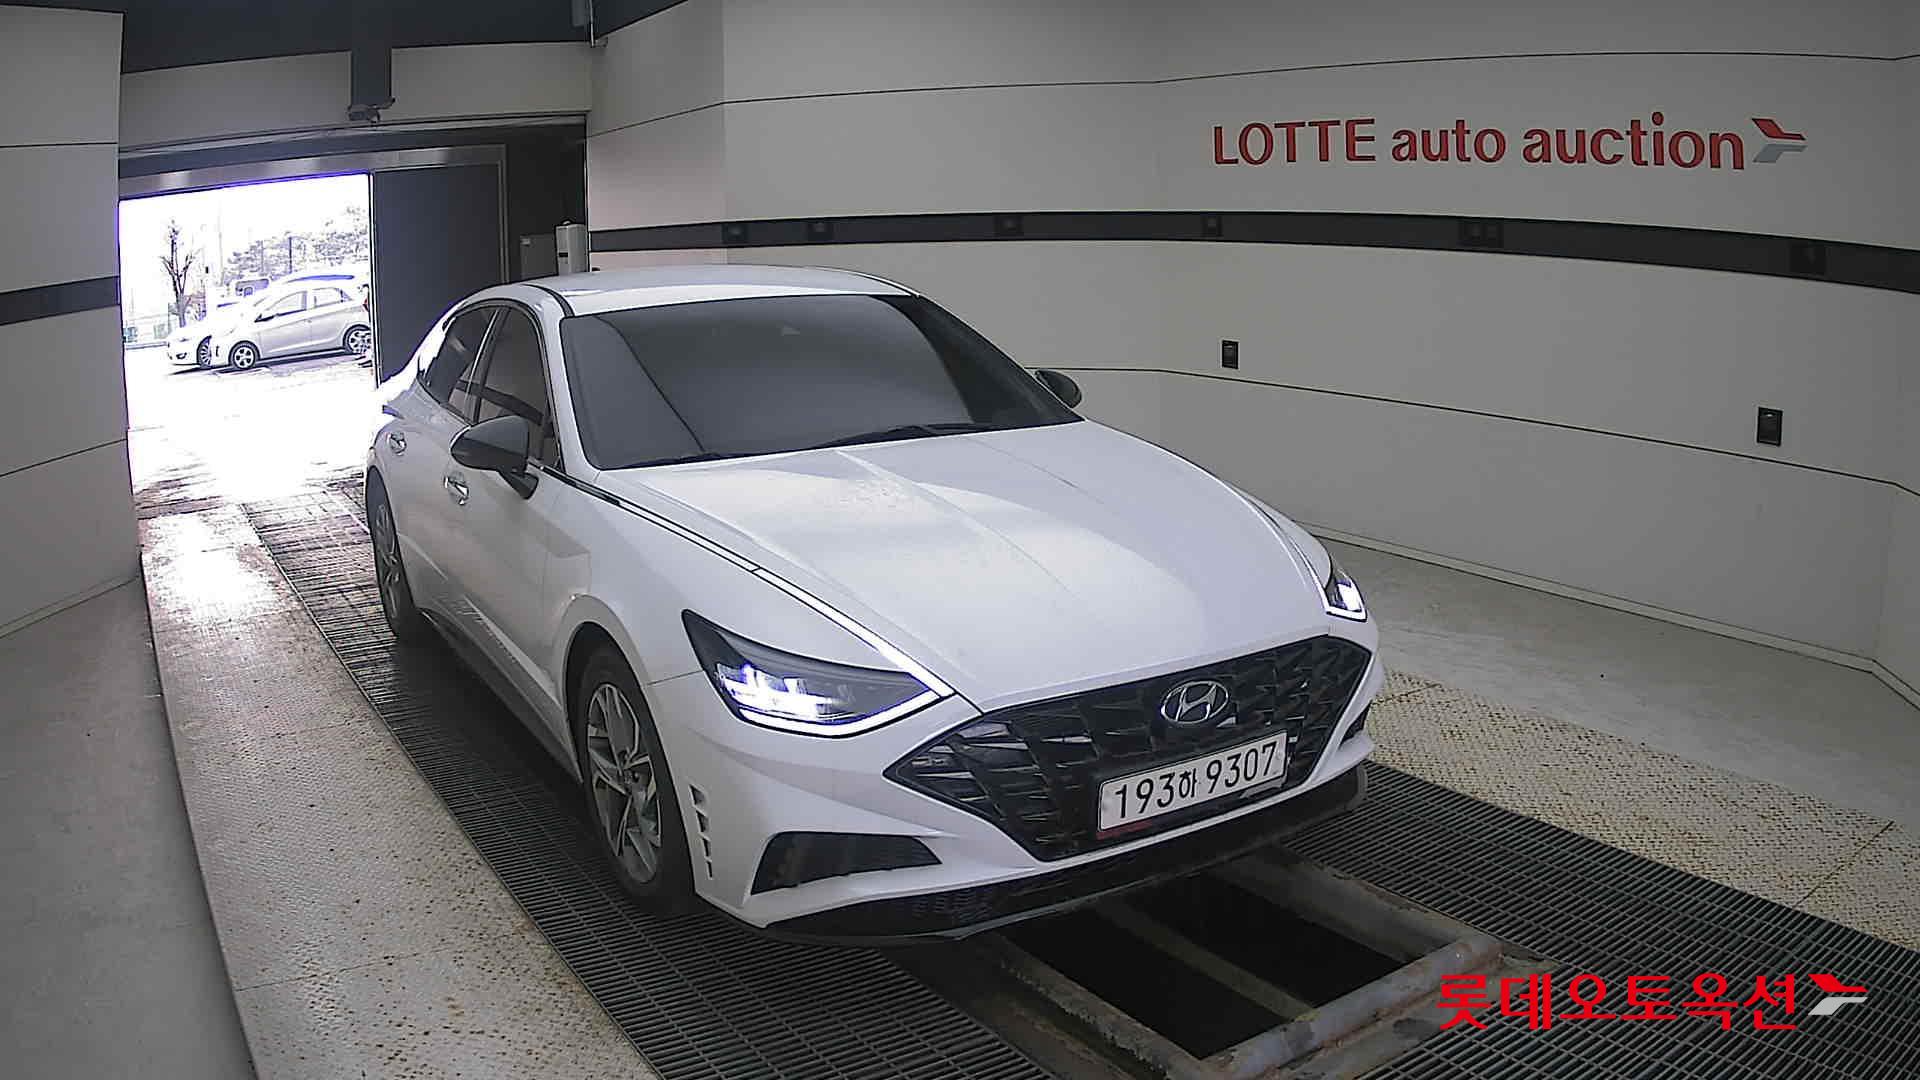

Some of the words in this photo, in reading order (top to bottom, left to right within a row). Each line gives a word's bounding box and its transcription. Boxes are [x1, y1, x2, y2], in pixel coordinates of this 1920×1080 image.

[1213, 118, 1376, 165] LOTTE
[1391, 119, 1506, 163] auto
[1522, 111, 1745, 170] auction
[1115, 768, 1198, 819] 193하
[1206, 741, 1278, 794] 9307
